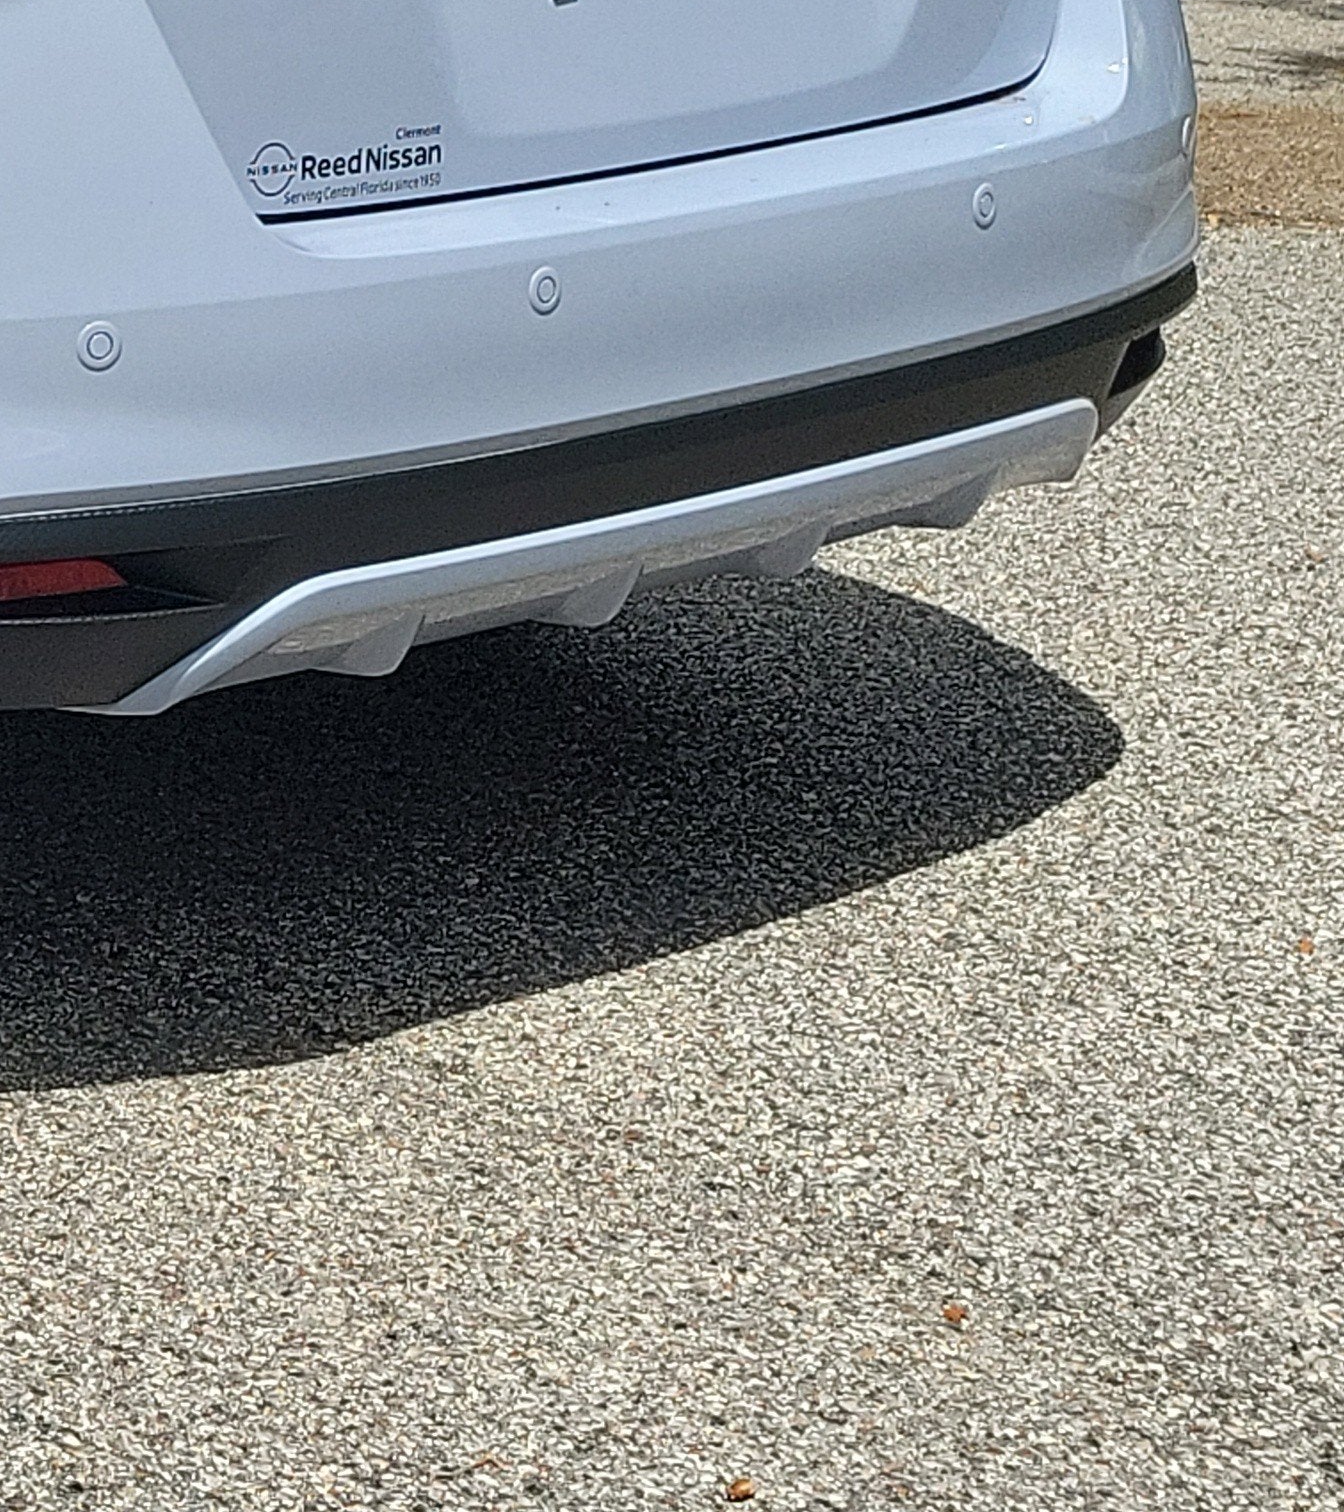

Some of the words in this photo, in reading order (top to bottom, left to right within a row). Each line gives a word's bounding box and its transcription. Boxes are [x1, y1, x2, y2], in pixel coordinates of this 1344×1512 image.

[395, 125, 442, 140] Clermont
[246, 162, 298, 177] NISSAN
[300, 147, 363, 181] Reed
[365, 143, 442, 173] Nissan
[283, 190, 322, 205] Serving
[323, 184, 359, 200] Central
[360, 179, 393, 195] Florida
[394, 176, 419, 192] since
